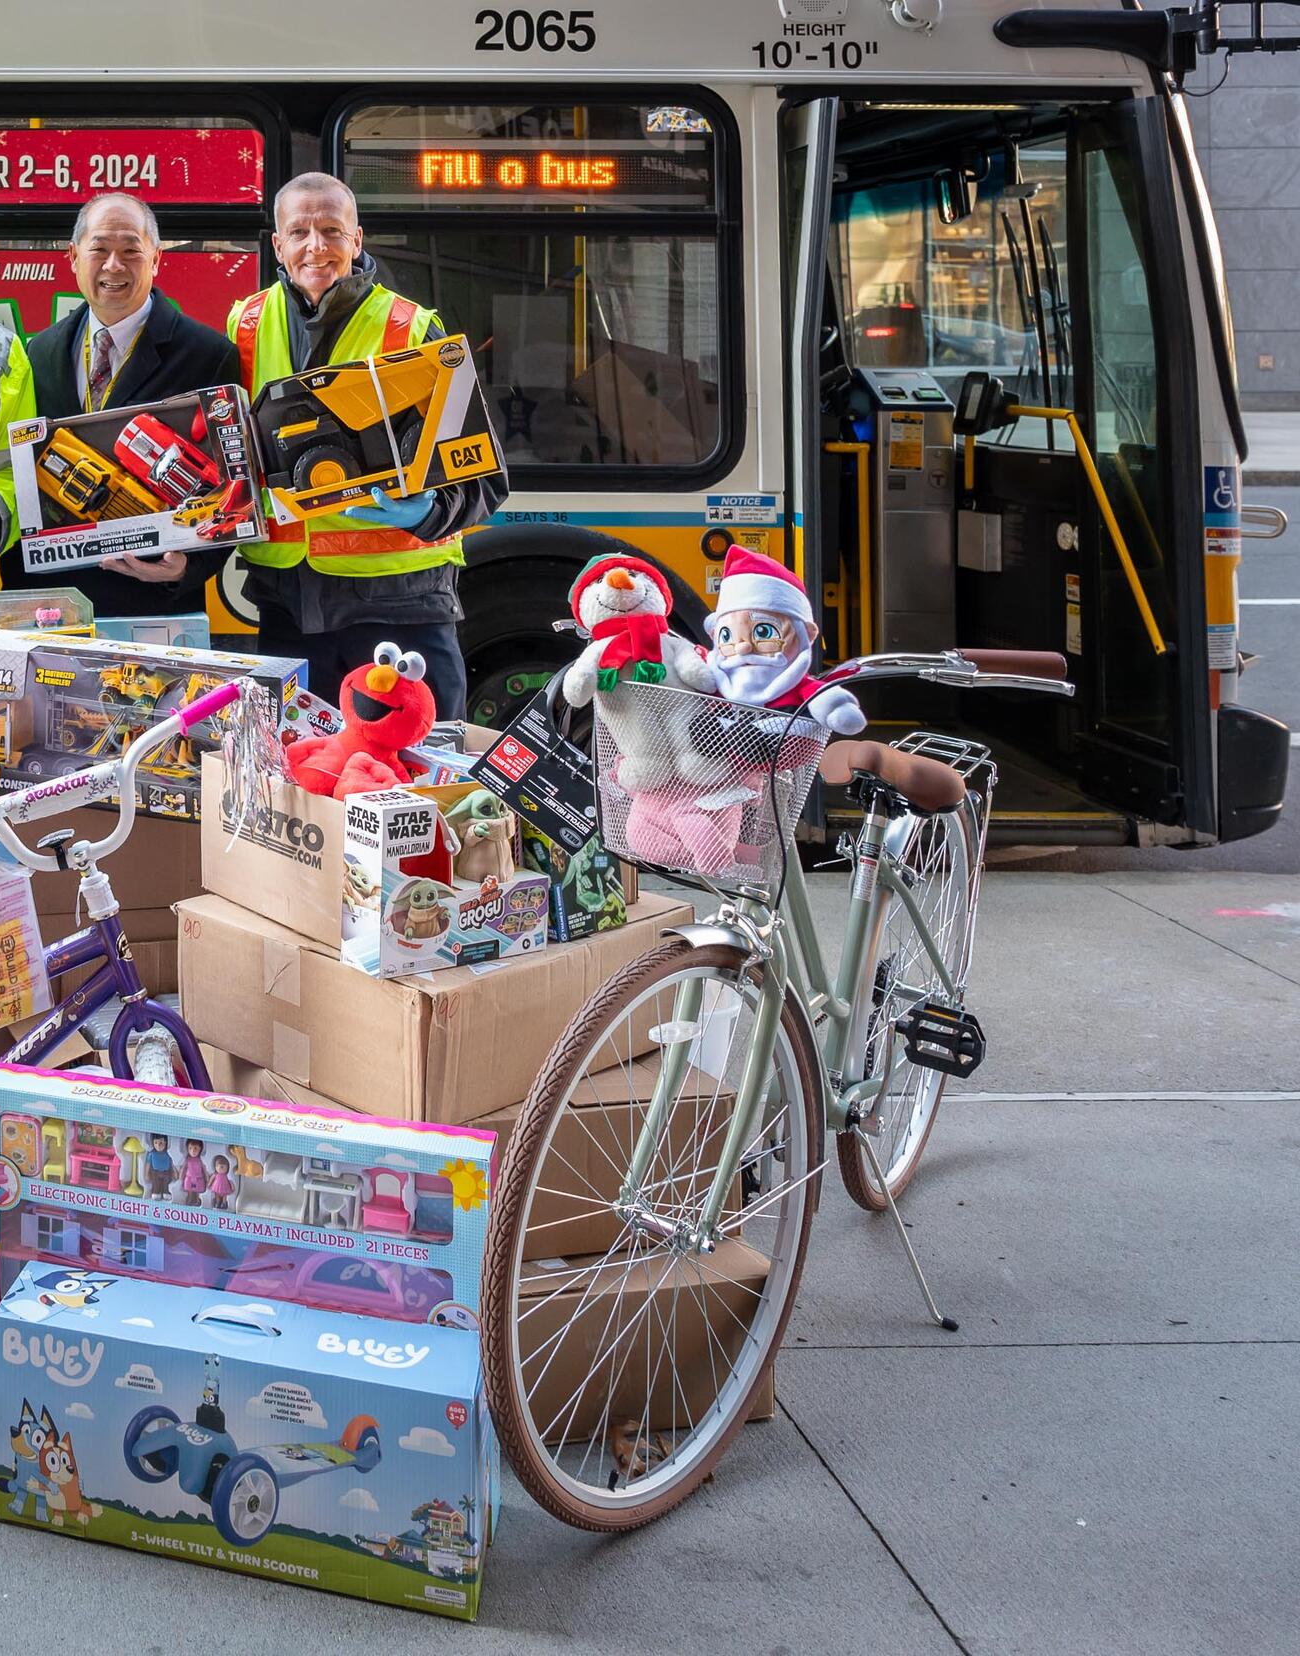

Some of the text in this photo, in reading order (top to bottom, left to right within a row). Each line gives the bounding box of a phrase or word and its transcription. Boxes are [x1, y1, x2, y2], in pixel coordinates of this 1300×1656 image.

[474, 10, 597, 52] 2065
[783, 23, 847, 37] HEIGHT
[89, 154, 158, 188] 2024
[420, 153, 615, 186] Fill bus
[1, 263, 55, 281] ANNUAL
[311, 375, 326, 387] CAT
[11, 427, 28, 437] NEW
[12, 430, 40, 445] BRIGHT
[450, 443, 483, 469] CAT
[342, 486, 363, 497] STEEL
[721, 497, 762, 506] NOTICE
[505, 511, 568, 523] SEATS 36
[28, 534, 85, 548] RC ROAD
[100, 535, 144, 547] CUSTOM CHEVY
[100, 541, 153, 554] CUSTOM MUSTANG
[29, 542, 85, 565] RALLY
[35, 668, 45, 683] 3
[307, 713, 337, 734] COLLECT
[347, 805, 380, 824] STAR
[347, 814, 380, 834] WARS
[388, 810, 432, 827] STAR
[543, 797, 590, 834] BICYCLE HELMET
[388, 822, 432, 841] WARS
[562, 830, 580, 846] BELL
[293, 850, 322, 870] .COM
[386, 842, 430, 858] MANDALORIAN
[458, 899, 503, 930] GROGU
[184, 918, 201, 939] 90
[5, 954, 19, 986] BUILD
[3, 1008, 65, 1063] HUFFY
[72, 1086, 124, 1101] DOLL
[124, 1092, 191, 1111] HOUSE
[250, 1112, 303, 1128] PLAY
[304, 1119, 343, 1133] SET
[30, 1184, 429, 1261] ELECTRONIC LIGHT & SOUND PLAYMAT INCLUDED 21 PIECES
[2, 1327, 105, 1388] BLUEY
[316, 1332, 430, 1369] BLUEY
[131, 1530, 320, 1580] 3-WHEEL TILT & TURN SCOOTER
